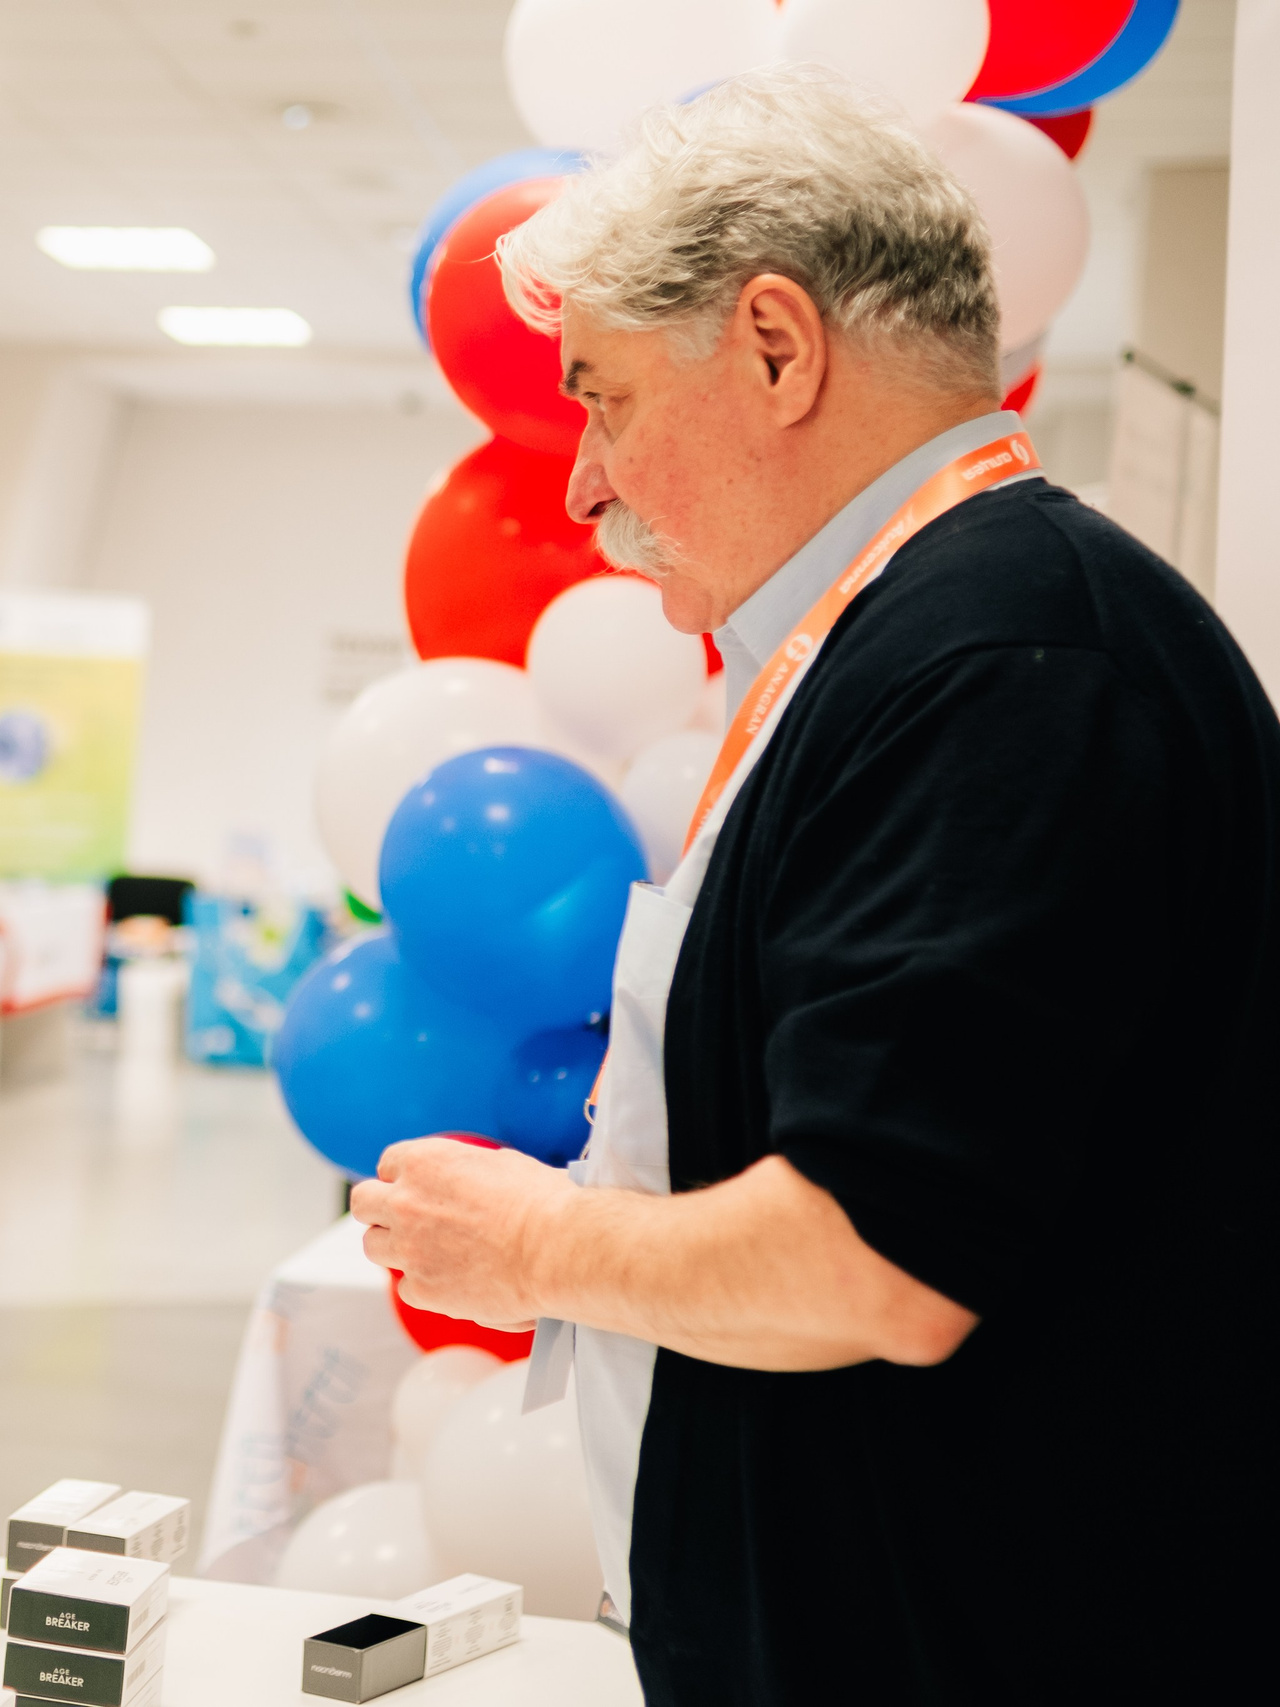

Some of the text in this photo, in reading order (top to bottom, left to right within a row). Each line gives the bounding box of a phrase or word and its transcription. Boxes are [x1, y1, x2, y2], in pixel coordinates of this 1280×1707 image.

[746, 663, 789, 734] ANAGRAN
[46, 1616, 90, 1632] BREAKER
[59, 1612, 76, 1620] AGE
[39, 1672, 83, 1688] BREAKER
[53, 1668, 70, 1676] AGE
